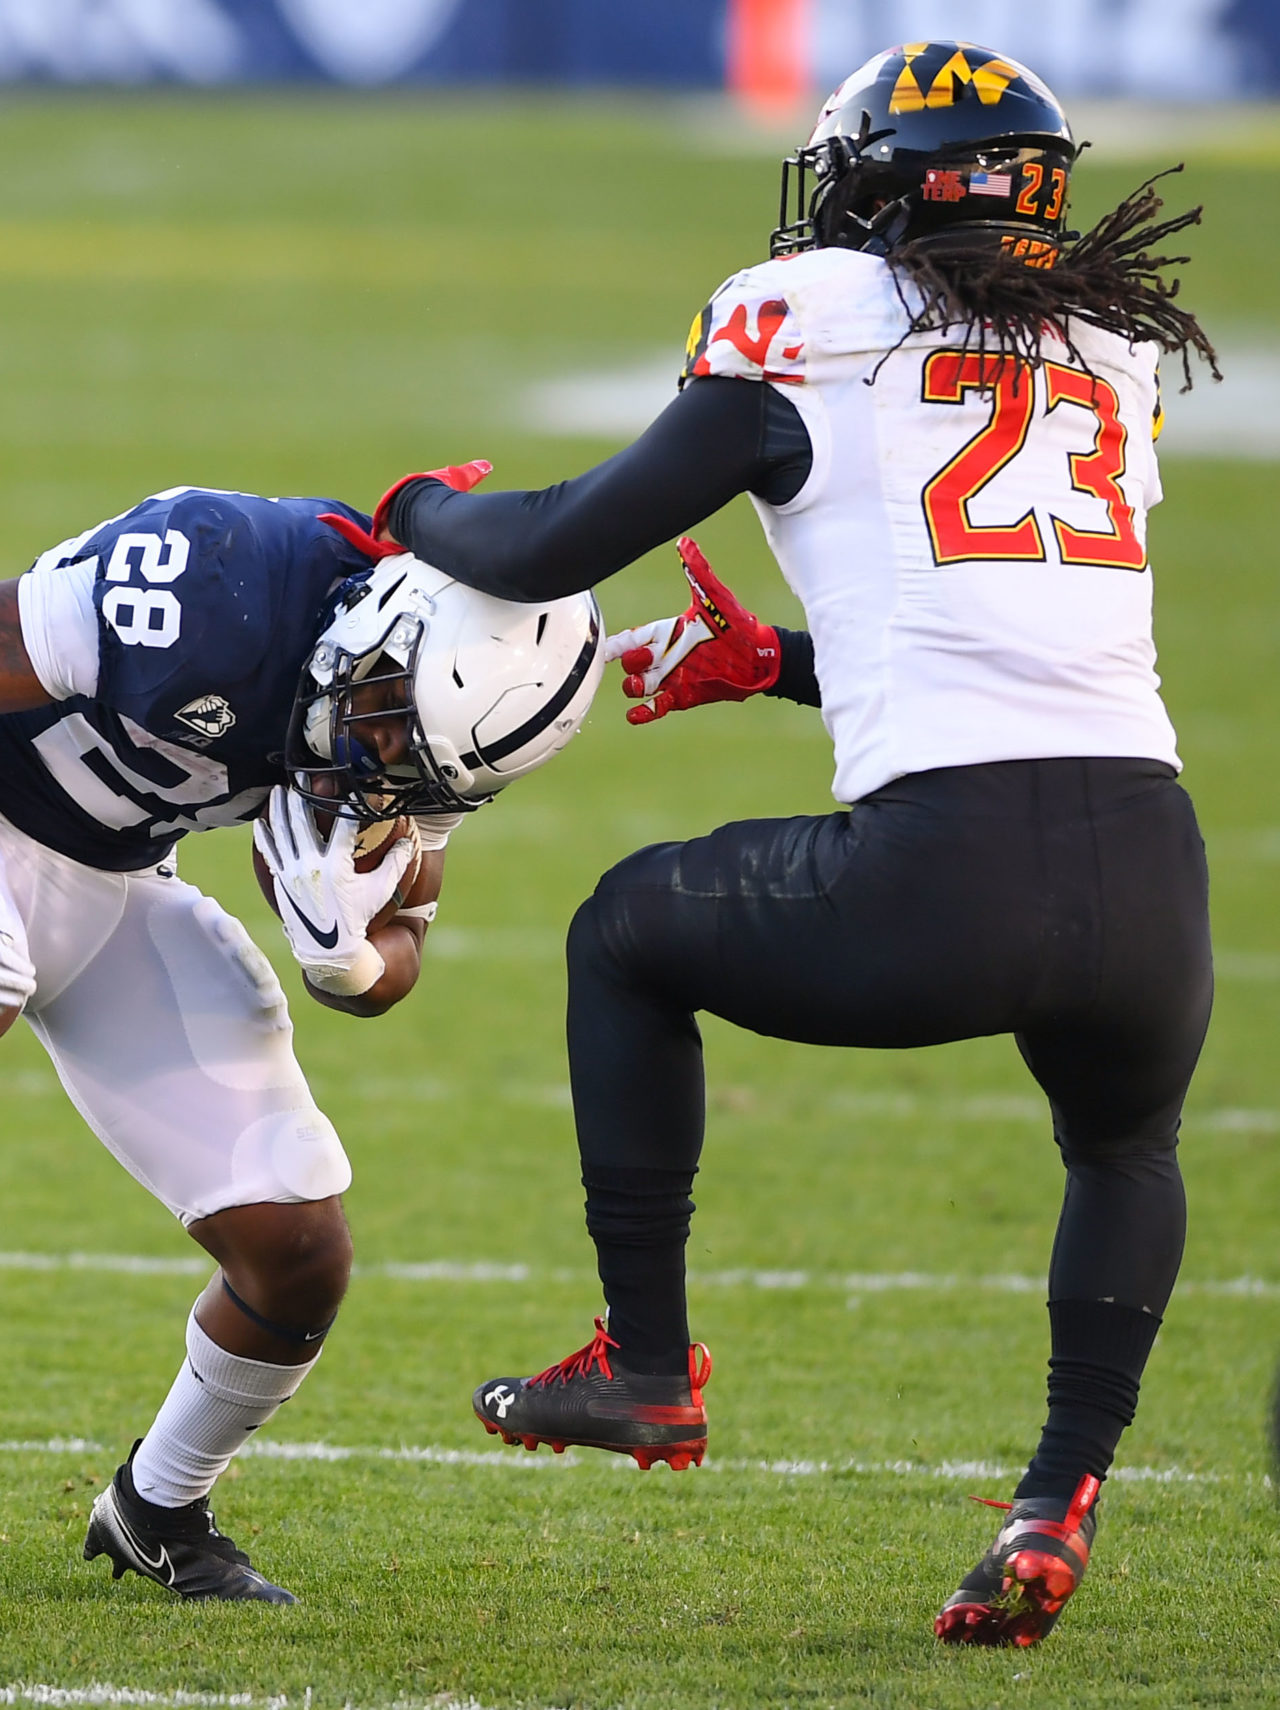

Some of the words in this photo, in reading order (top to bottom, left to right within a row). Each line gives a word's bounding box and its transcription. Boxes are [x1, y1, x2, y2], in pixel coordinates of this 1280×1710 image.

[1016, 163, 1065, 220] 23
[920, 348, 1148, 572] 23
[102, 528, 190, 648] 28
